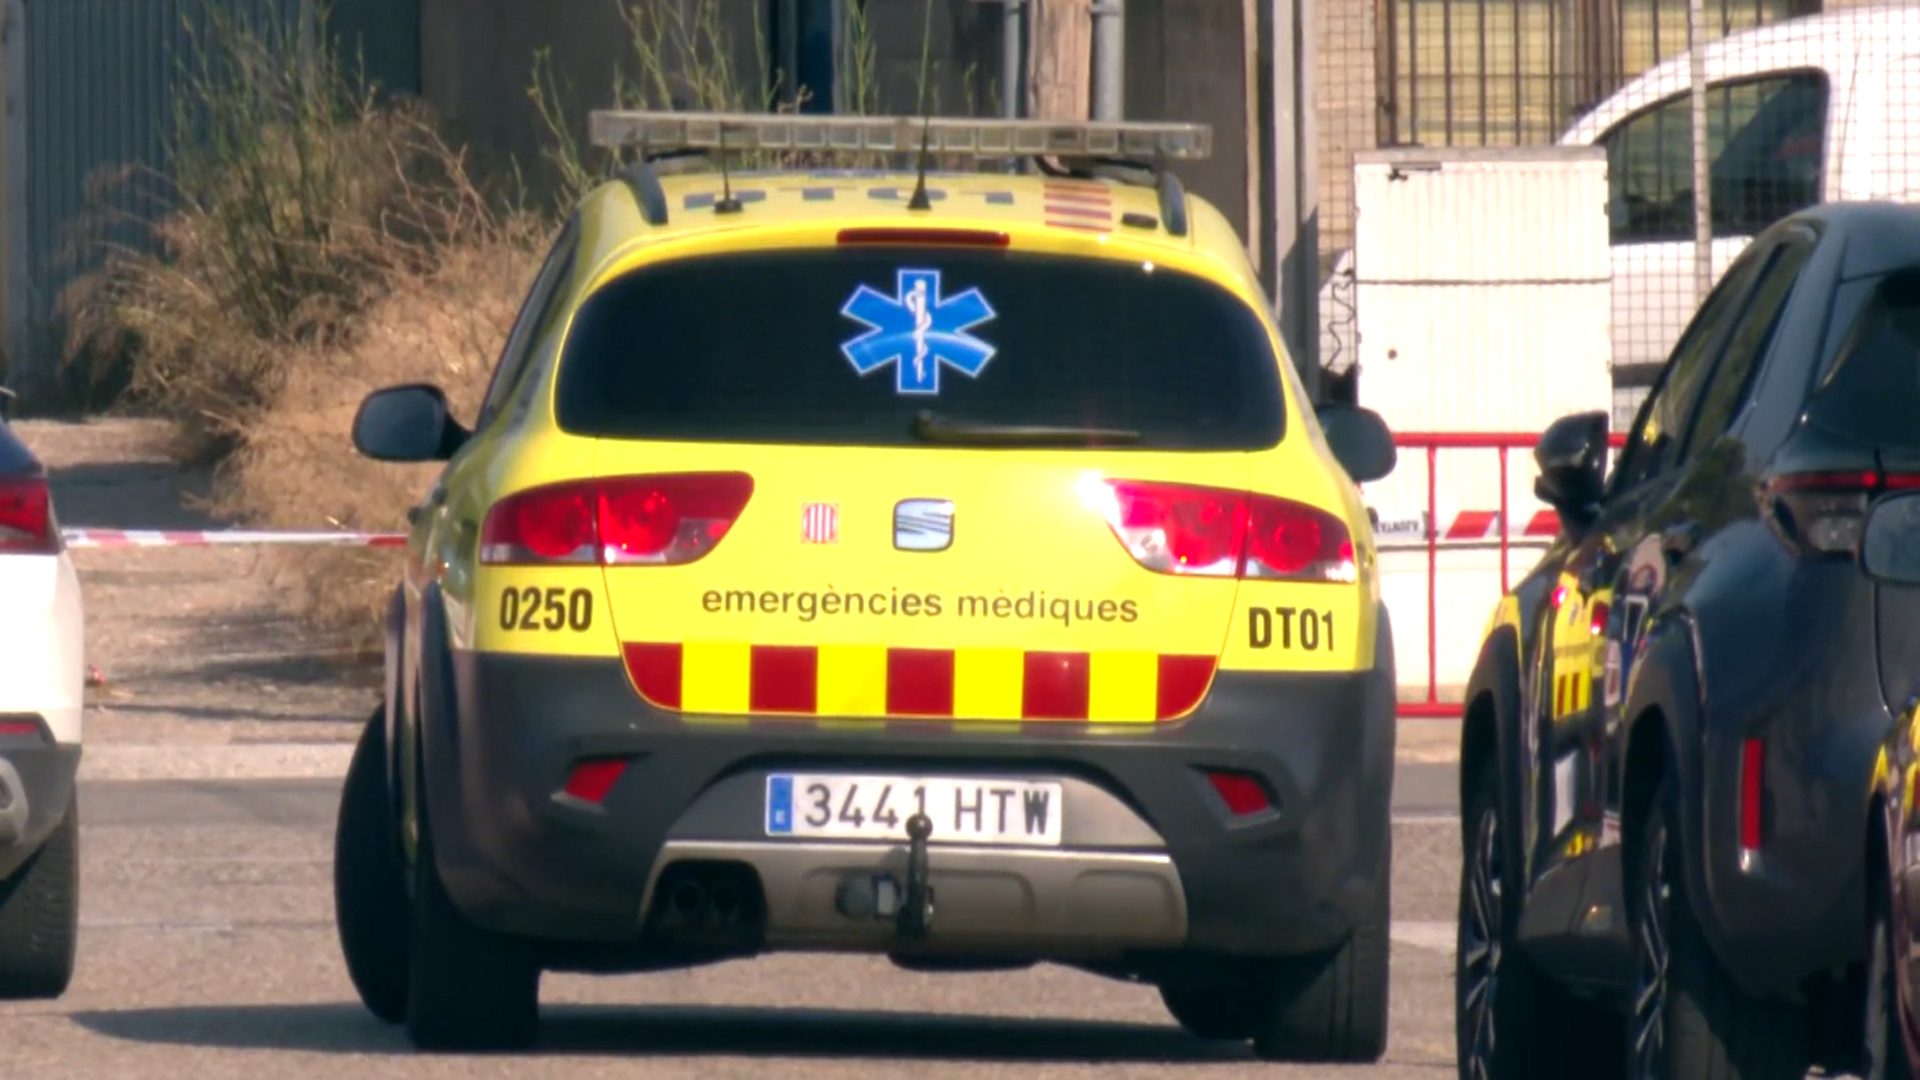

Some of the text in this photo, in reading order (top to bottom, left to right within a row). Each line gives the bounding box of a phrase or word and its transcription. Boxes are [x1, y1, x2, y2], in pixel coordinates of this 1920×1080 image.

[499, 586, 593, 632] 0250
[701, 584, 1139, 627] emergències mèdiques
[1249, 607, 1333, 651] DT01
[805, 783, 925, 829] 3441
[955, 787, 1049, 836] HTW
